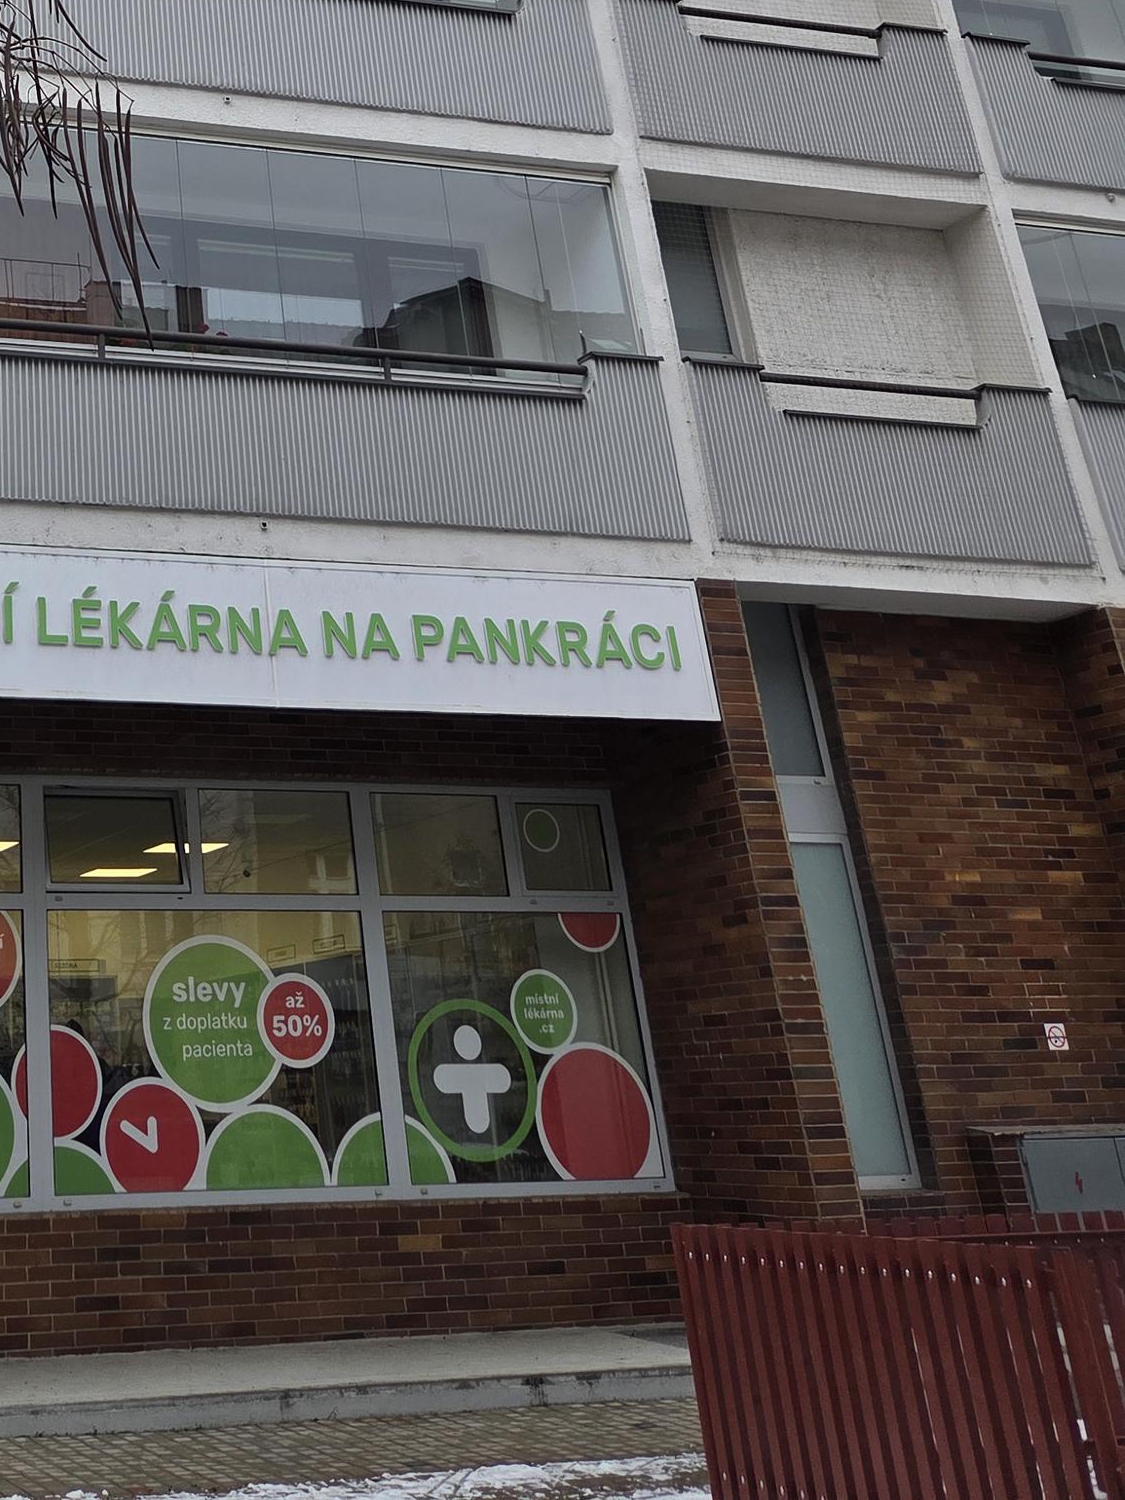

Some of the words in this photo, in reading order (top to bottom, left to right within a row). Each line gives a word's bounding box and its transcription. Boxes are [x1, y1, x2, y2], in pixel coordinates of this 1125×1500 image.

[37, 586, 308, 657] LÉKÁRNA
[321, 610, 401, 660] NA
[411, 610, 682, 671] PANKRÁCI
[172, 976, 246, 1008] slevy
[285, 991, 305, 1008] až
[525, 993, 560, 1005] místní
[163, 1017, 172, 1030] z
[176, 1013, 248, 1033] doplatku
[524, 1007, 564, 1019] lékárna
[272, 1014, 323, 1037] 50%
[539, 1024, 555, 1034] .cz
[182, 1040, 253, 1061] pacienta
